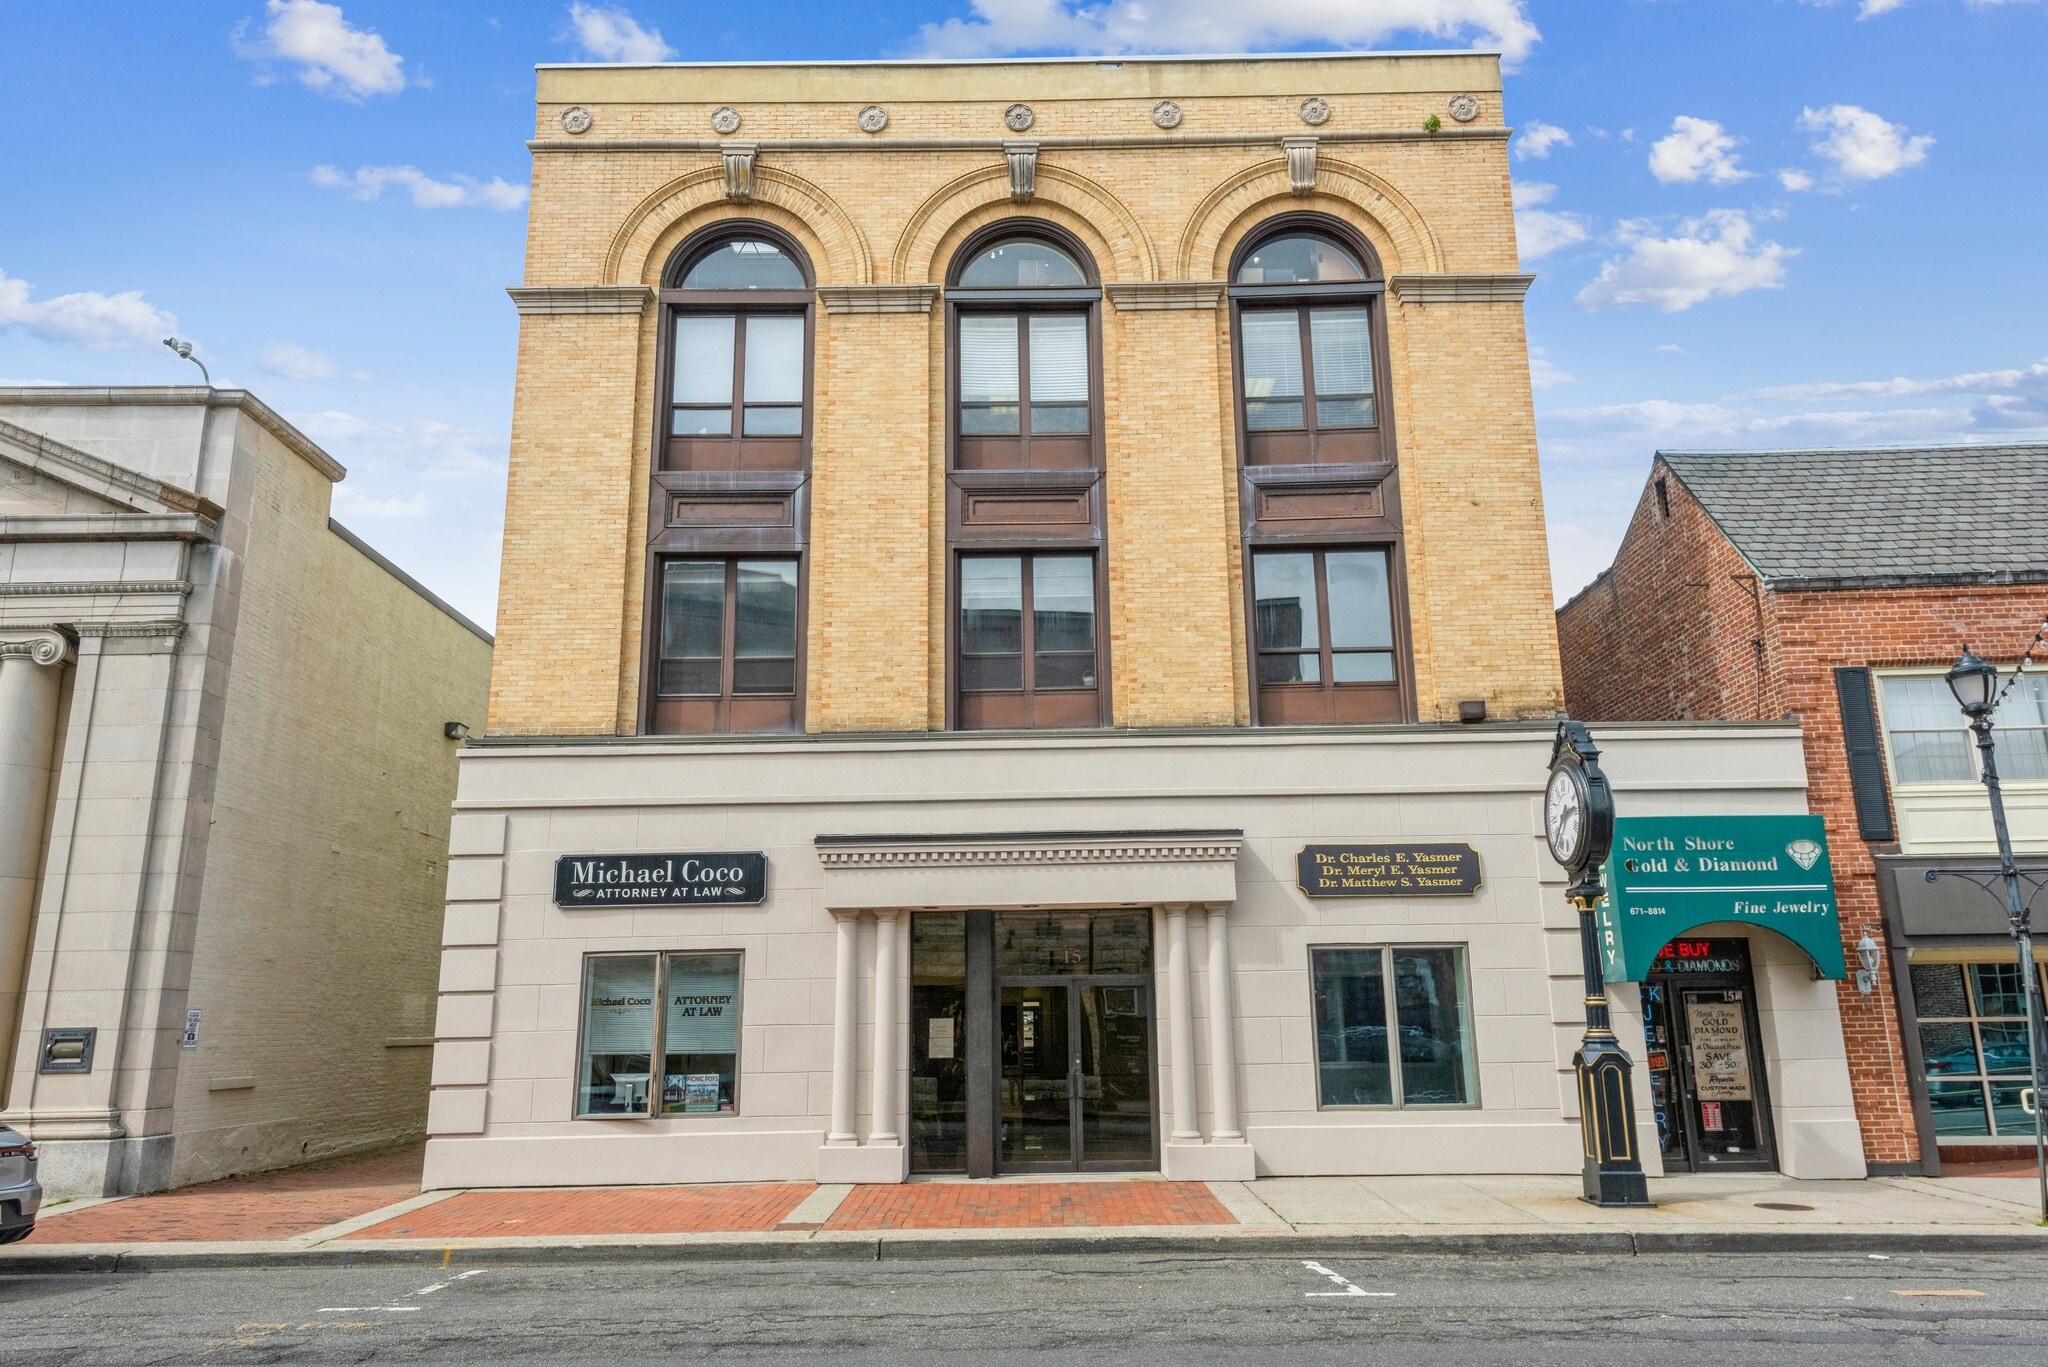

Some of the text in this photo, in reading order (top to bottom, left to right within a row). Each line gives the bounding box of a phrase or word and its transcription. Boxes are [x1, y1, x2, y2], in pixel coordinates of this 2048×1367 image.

[1623, 836, 1735, 851] North Shore
[1315, 853, 1463, 863] Dr. Charles E. Yasmer
[1322, 865, 1458, 878] Dr. Meryl E. Yasmer
[1624, 857, 1779, 873] Gold & Diamond
[570, 859, 744, 885] Michael Coco
[1319, 877, 1463, 888] Dr. Matthew S. Yasmer
[596, 886, 722, 898] ATTORNEY AT LAW
[1629, 901, 1830, 916] 671-8814 Fine Jewelry
[1678, 942, 1710, 957] BUY
[1063, 949, 1081, 964] 15
[1665, 960, 1674, 972] &
[1677, 959, 1740, 973] DIAMONDS
[590, 995, 732, 1007] Michael Coco ATTORNEY
[681, 1007, 723, 1017] AT LAW
[1702, 1018, 1729, 1026] GOLD
[1648, 1056, 1666, 1068] LOSED
[1705, 1052, 1732, 1061] SAVE
[1643, 1004, 1669, 1151] JEELRY
